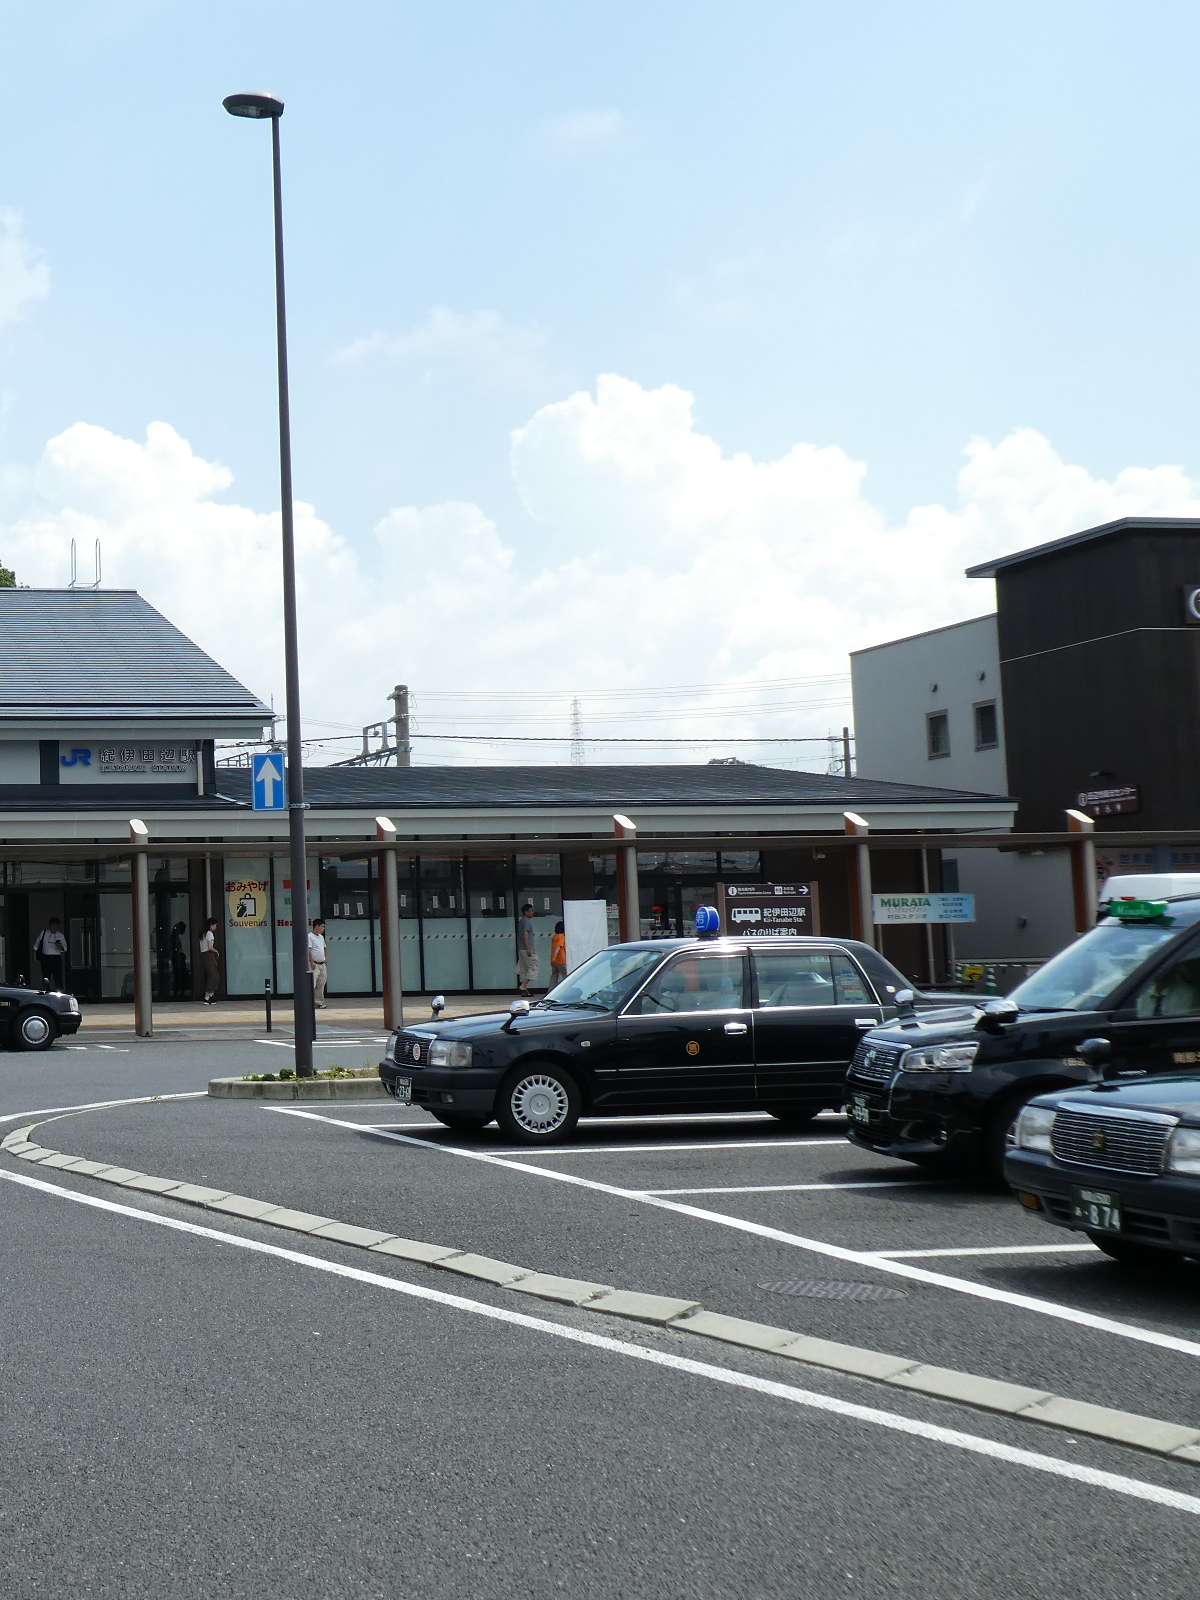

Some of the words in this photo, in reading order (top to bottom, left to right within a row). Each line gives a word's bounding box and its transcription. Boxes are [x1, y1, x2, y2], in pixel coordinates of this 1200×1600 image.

[61, 748, 92, 766] JR
[101, 748, 196, 763] 紀伊田辺駅
[225, 880, 269, 892] おみやげ
[880, 897, 932, 908] MURATA
[762, 907, 806, 917] 紀伊田辺駅
[229, 919, 268, 928] Souvenirs
